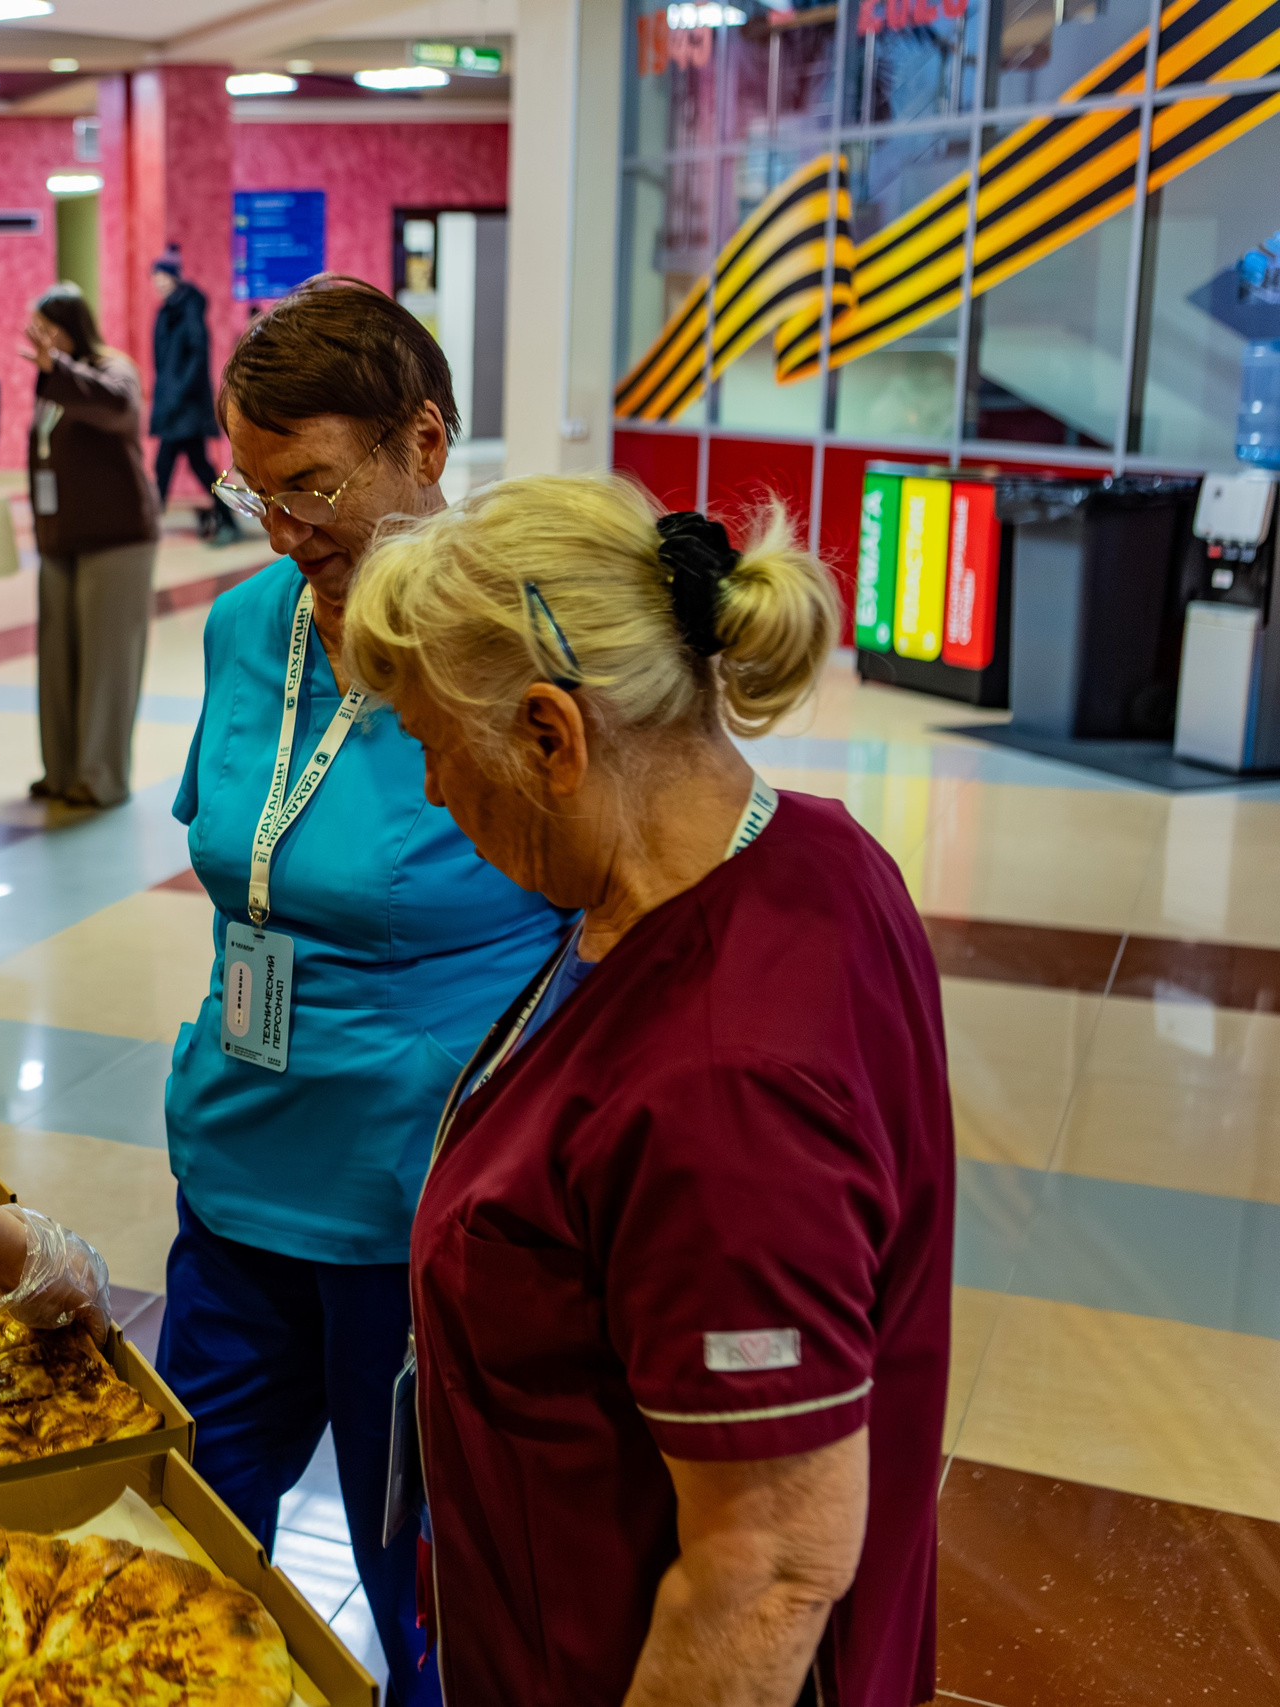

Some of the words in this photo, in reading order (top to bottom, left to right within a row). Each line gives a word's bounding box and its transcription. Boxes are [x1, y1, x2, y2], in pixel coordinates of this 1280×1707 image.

[288, 607, 307, 691] САХАЛИН
[263, 955, 275, 1046] ТЕХНИЧЕСКИЙ
[273, 980, 284, 1050] ПЕРСОНАЛ
